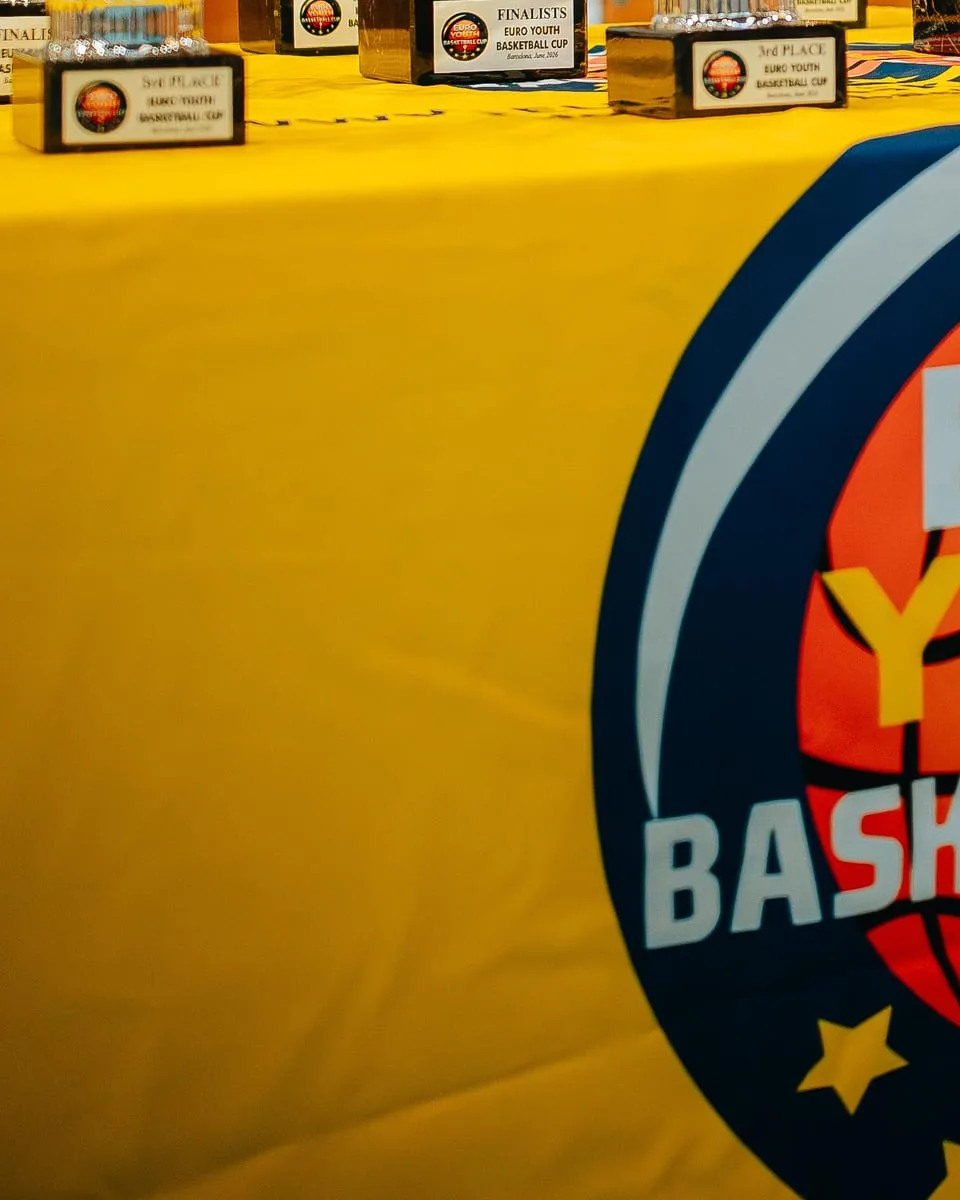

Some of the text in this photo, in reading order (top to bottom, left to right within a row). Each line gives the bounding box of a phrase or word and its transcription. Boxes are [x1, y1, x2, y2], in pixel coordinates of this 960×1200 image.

[497, 7, 567, 20] FINALISTS
[504, 25, 560, 36] EURO YOUTH
[496, 39, 568, 51] BASKETBALL CUP
[758, 43, 826, 57] 3rd PLACE
[764, 63, 820, 73] EURO YOUTH
[756, 78, 807, 88] BASKETBALL
[811, 77, 828, 86] CUP
